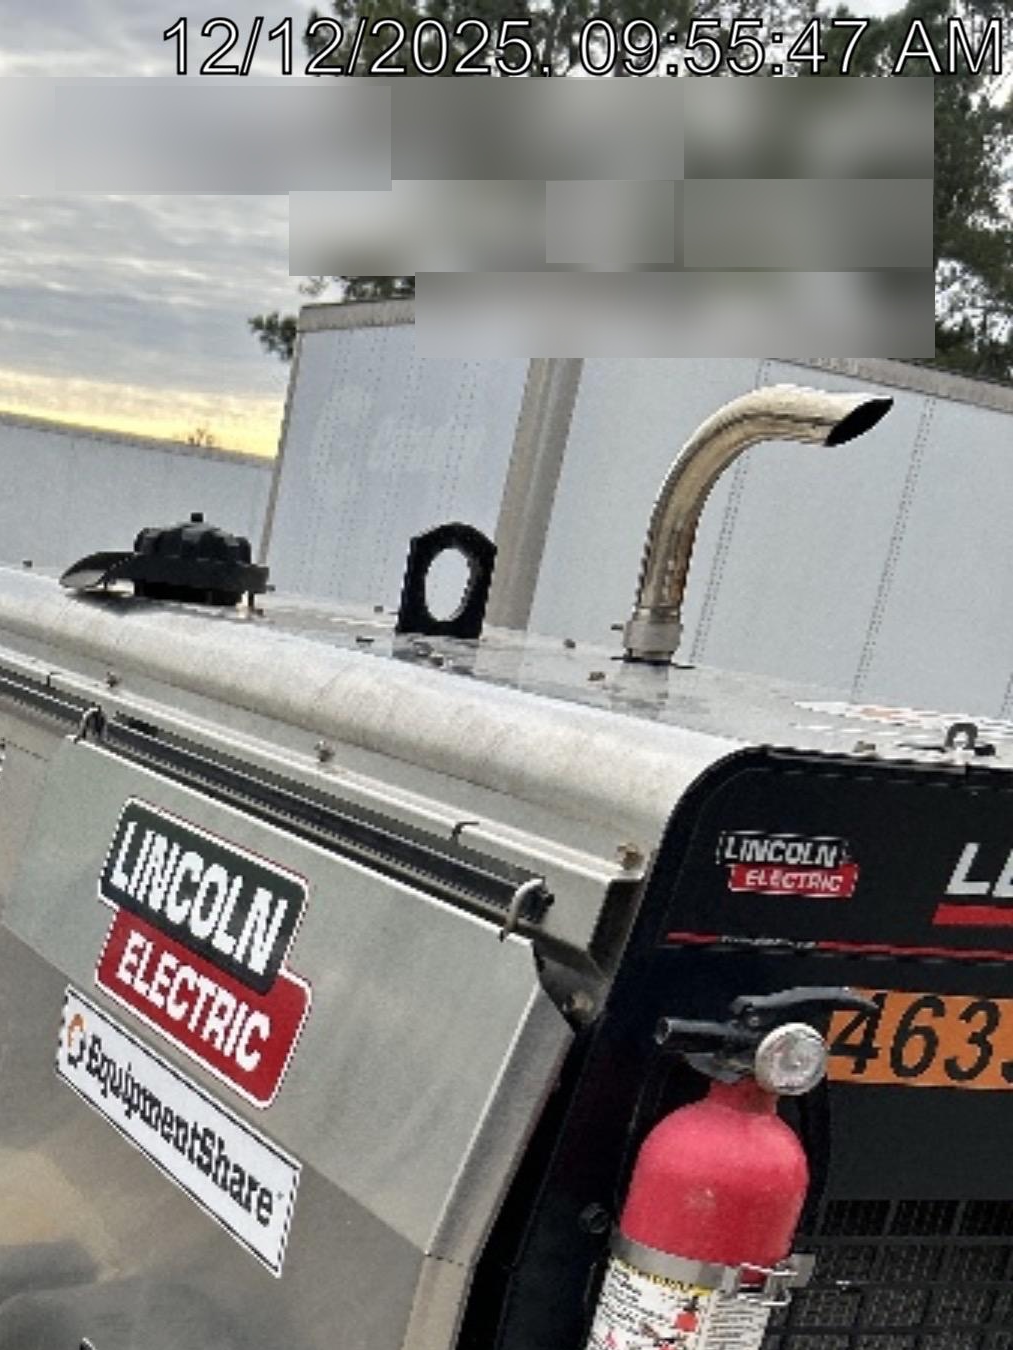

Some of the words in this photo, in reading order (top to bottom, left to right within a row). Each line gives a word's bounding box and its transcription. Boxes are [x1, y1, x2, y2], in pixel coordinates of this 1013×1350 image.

[109, 821, 288, 977] LINCOLN
[724, 836, 838, 868] LINCOLN
[745, 869, 844, 892] ELECTRIC
[115, 929, 272, 1074] ELECTRIC
[85, 1031, 276, 1229] EquipmentShare
